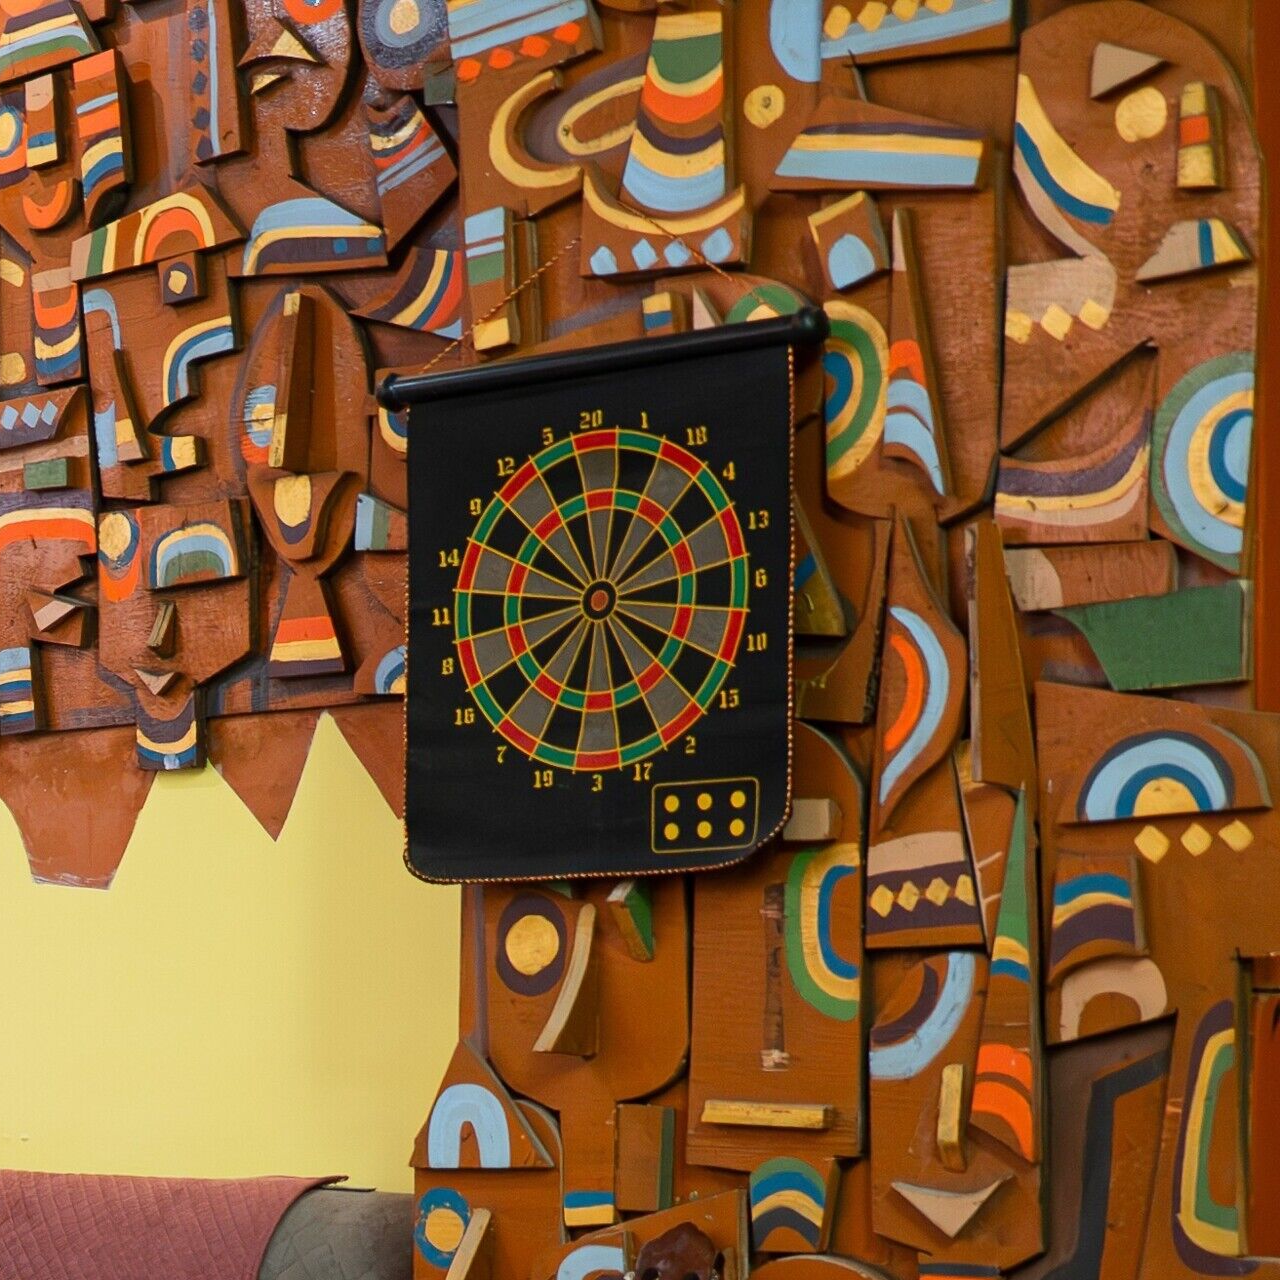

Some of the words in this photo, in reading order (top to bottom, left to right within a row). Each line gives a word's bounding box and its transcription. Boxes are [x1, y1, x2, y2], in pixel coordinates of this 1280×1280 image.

[579, 409, 602, 429] 20
[640, 411, 649, 429] 1
[542, 427, 555, 445] 5
[686, 425, 708, 446] 18
[496, 457, 516, 477] 12
[722, 461, 736, 481] 4
[469, 498, 482, 516] 9
[748, 509, 770, 530] 13
[438, 549, 460, 568] 14
[754, 567, 768, 589] 6
[431, 607, 452, 627] 11
[746, 632, 768, 652] 10
[441, 656, 455, 676] 8
[719, 689, 740, 709] 15
[454, 707, 476, 726] 16
[496, 745, 508, 764] 7
[684, 735, 697, 755] 2
[532, 768, 554, 789] 19
[631, 762, 654, 782] 17
[591, 773, 603, 793] 3
